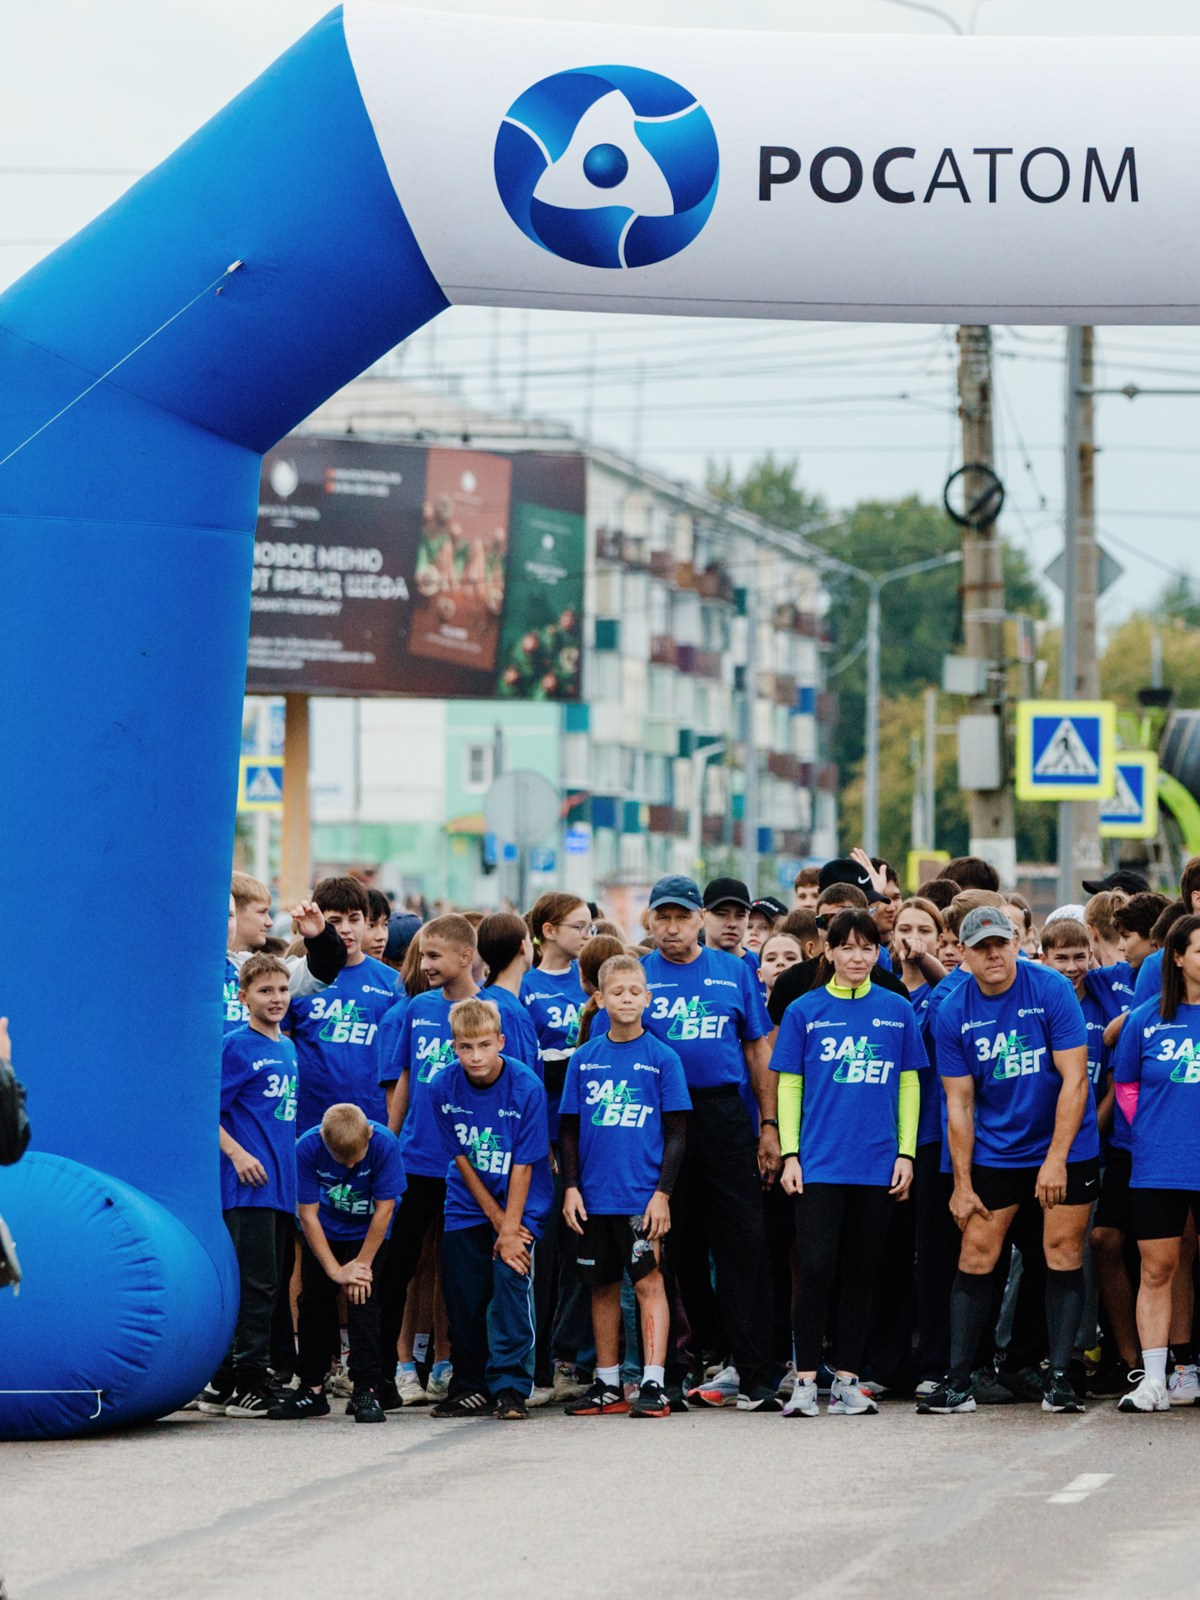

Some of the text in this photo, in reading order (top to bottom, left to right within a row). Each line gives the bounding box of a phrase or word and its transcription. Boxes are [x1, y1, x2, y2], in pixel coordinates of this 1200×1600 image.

[758, 145, 1140, 203] РОСАТОМ
[308, 997, 355, 1021] ЗА!
[650, 995, 700, 1020] ЗА!
[681, 1015, 730, 1040] БЕГ
[819, 1035, 868, 1062] ЗА!
[974, 1029, 1017, 1062] ЗА!
[846, 1060, 895, 1084] БЕГ
[1004, 1047, 1047, 1079] БЕГ
[585, 1079, 628, 1106] ЗА!
[602, 1103, 654, 1129] БЕГ
[454, 1123, 493, 1150] ЗА!
